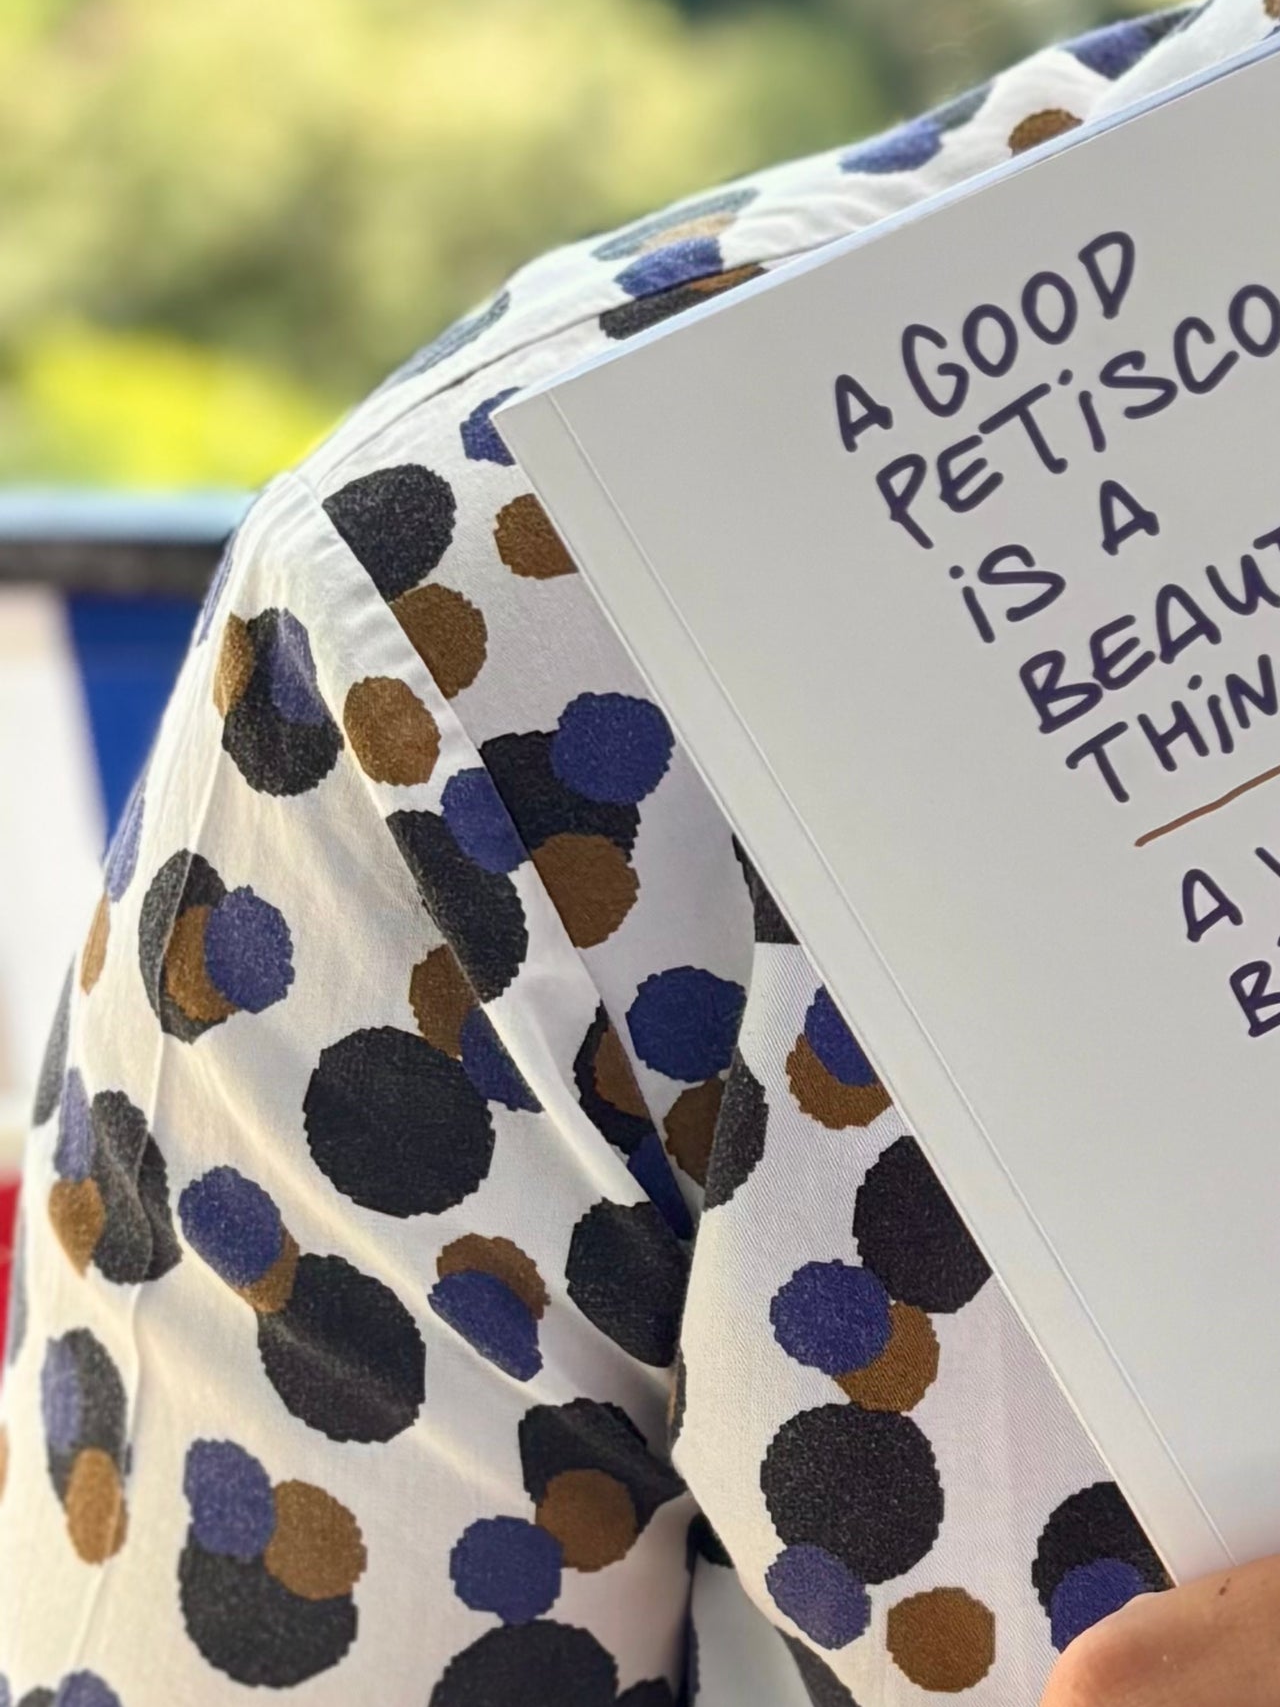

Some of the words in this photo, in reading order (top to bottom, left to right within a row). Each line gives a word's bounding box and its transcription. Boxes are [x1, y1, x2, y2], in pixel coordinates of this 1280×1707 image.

[835, 374, 893, 452] A
[901, 231, 1135, 417] GOOD
[1100, 480, 1160, 556] A
[1182, 869, 1243, 943] A
